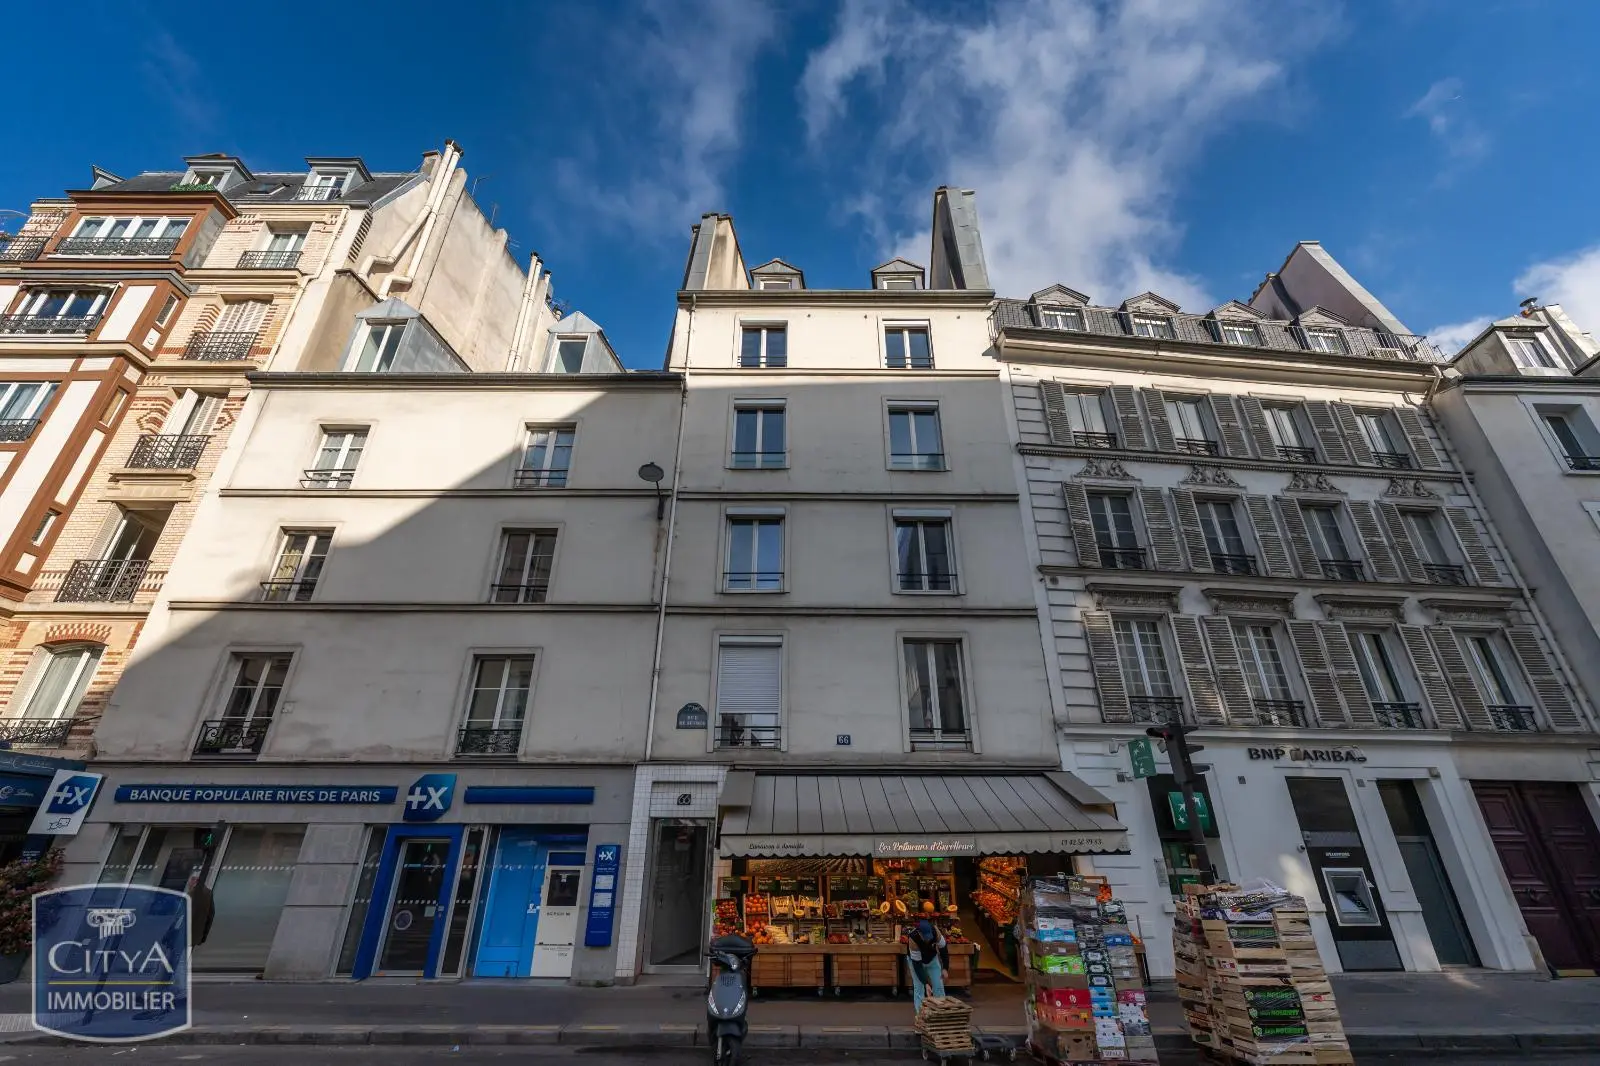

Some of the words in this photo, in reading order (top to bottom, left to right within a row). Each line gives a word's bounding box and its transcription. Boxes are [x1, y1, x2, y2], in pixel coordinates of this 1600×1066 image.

[838, 735, 849, 744] 66
[1247, 747, 1286, 761] BNP
[1291, 748, 1368, 763] ARIBA
[130, 789, 192, 802] BANQUE
[193, 789, 274, 802] POPULAIRE
[276, 790, 315, 802] RIVES
[318, 791, 337, 802] DE
[340, 791, 381, 802] PARIS
[678, 794, 691, 805] 66
[893, 841, 928, 852] Primeurs
[930, 840, 976, 851] d'Excellence
